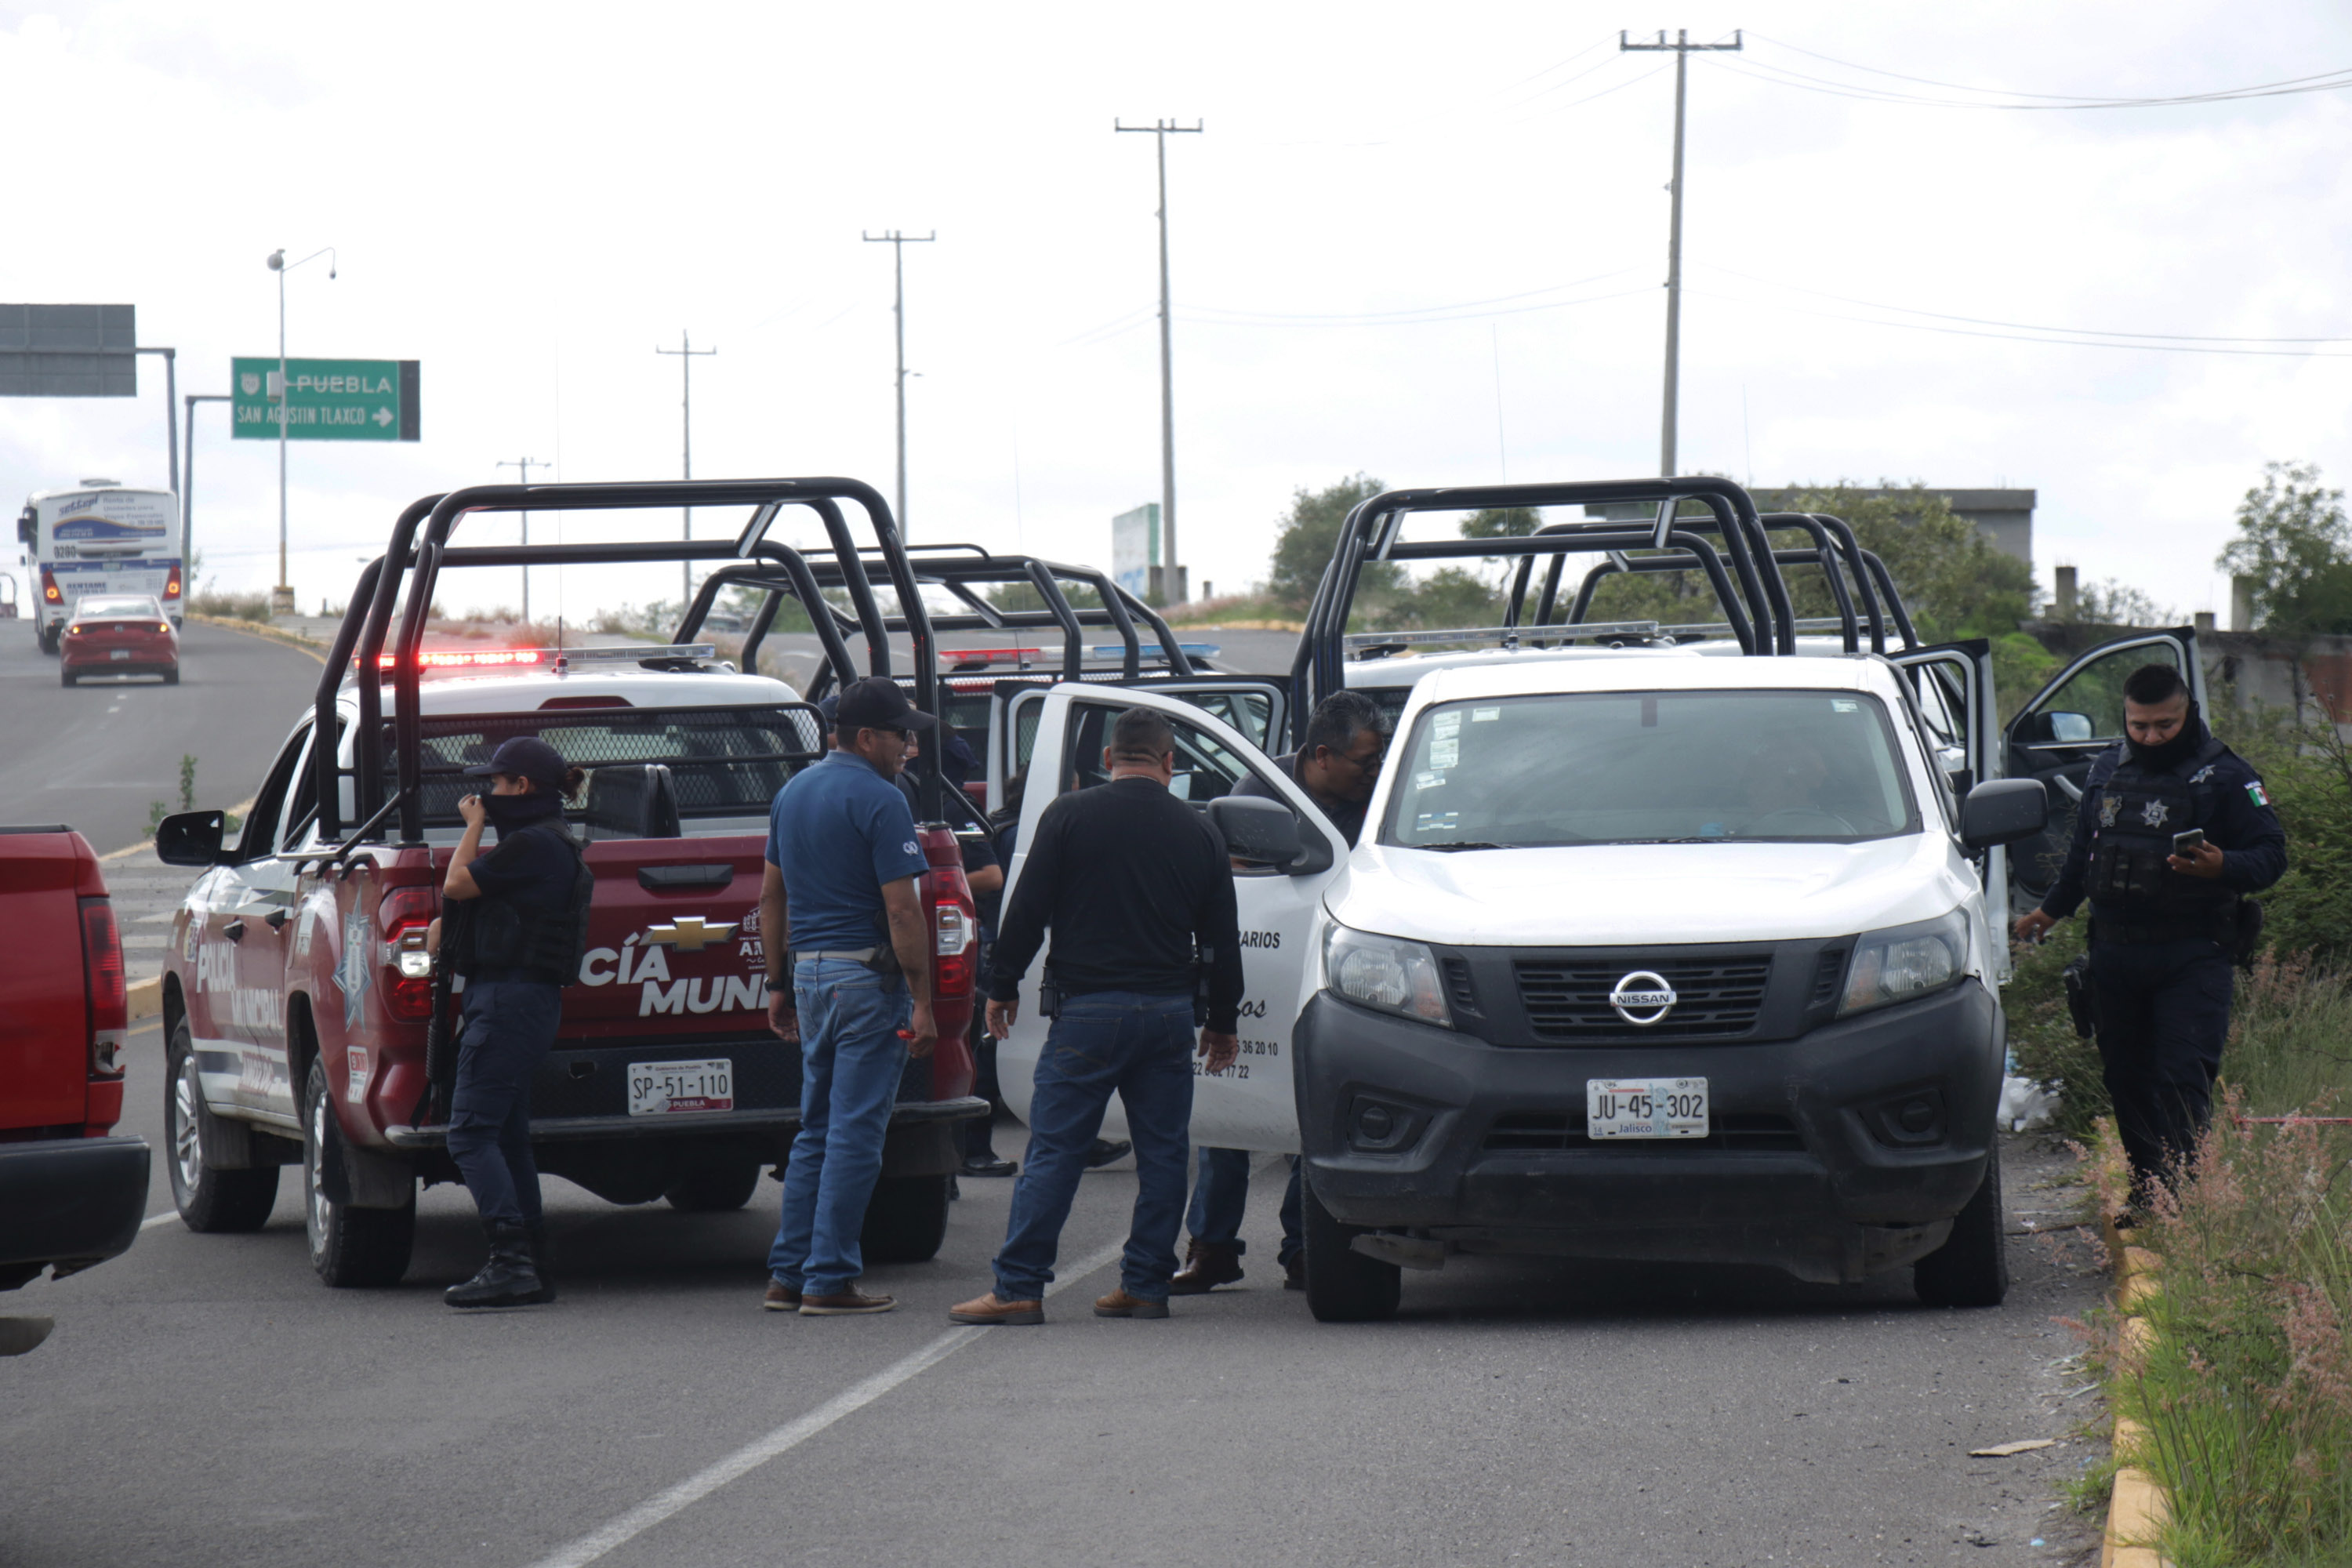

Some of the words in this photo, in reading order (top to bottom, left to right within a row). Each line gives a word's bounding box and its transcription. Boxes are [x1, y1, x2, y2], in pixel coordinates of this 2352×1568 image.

[297, 376, 392, 394] PUEBLA
[238, 406, 261, 424] SAN
[321, 407, 365, 425] TLAXCO
[1238, 931, 1280, 949] ARIOS
[578, 932, 671, 987] CÍA
[1617, 994, 1670, 1004] NISSAN
[1240, 999, 1268, 1019] os
[1243, 1040, 1254, 1054] 36
[1255, 1041, 1266, 1055] 20
[1268, 1042, 1279, 1056] 10
[1239, 1065, 1250, 1079] 22
[633, 1074, 728, 1100] SP-51-110
[673, 1099, 706, 1108] PUEBLA
[1592, 1094, 1704, 1120] JU-45-302
[1619, 1123, 1652, 1134] Jalisco
